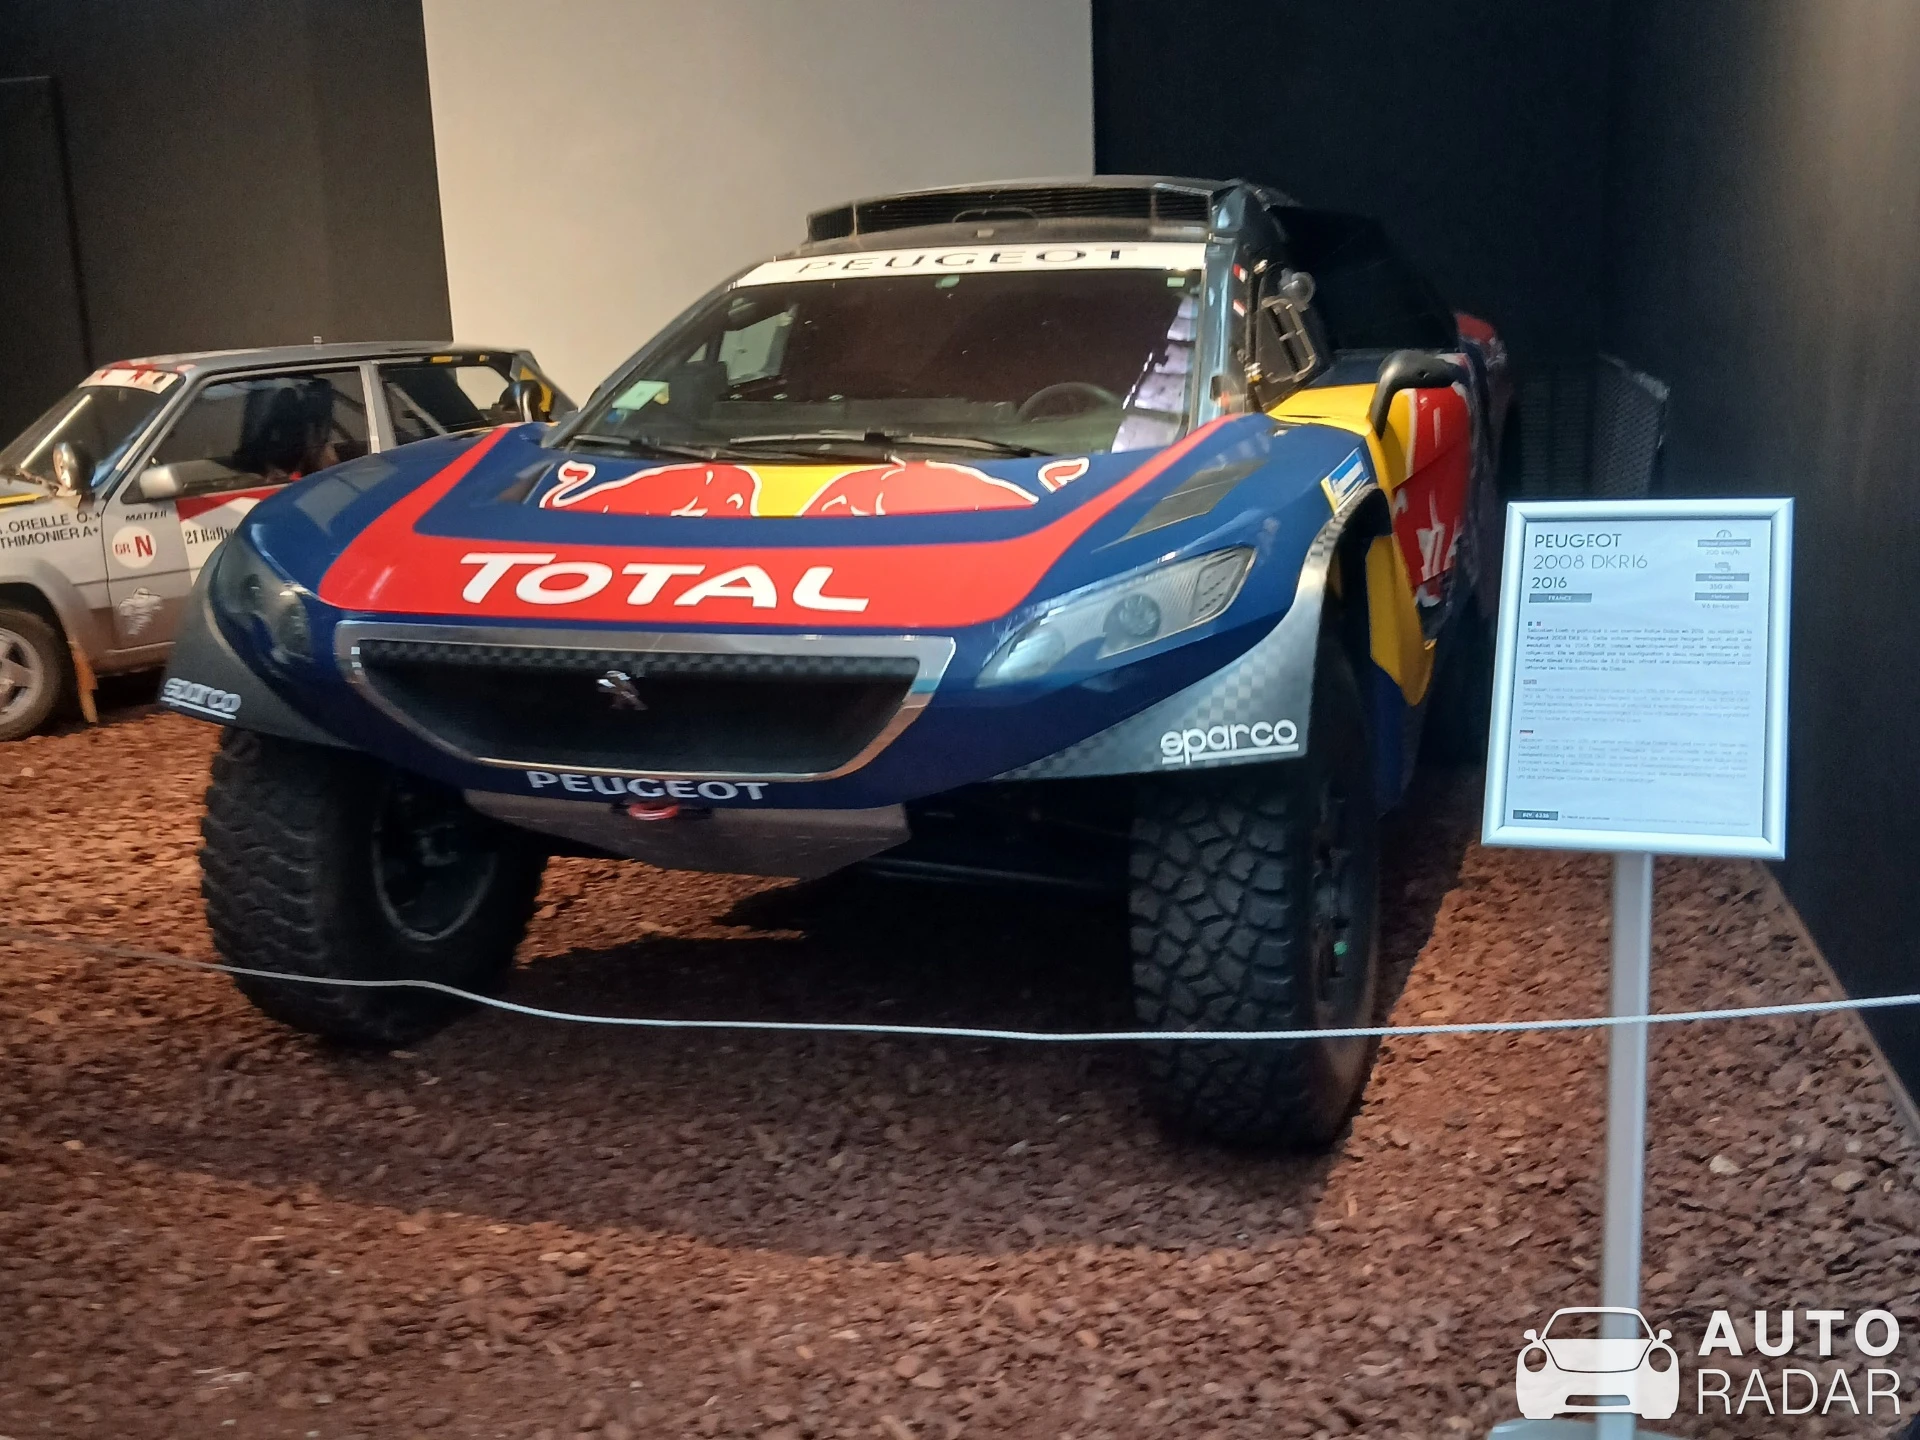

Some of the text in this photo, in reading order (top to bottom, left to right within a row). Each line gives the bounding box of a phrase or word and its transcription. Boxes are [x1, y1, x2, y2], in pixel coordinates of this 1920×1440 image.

[797, 249, 1138, 274] PEUGEOT
[0, 527, 80, 549] THIMONIER
[134, 535, 153, 557] N
[1534, 533, 1622, 549] PEUGEOT
[1533, 554, 1585, 570] 2008
[459, 552, 870, 612] TOTAL
[1531, 576, 1568, 589] 2016
[1160, 719, 1298, 764] sparco
[526, 771, 769, 800] PEUGEOT
